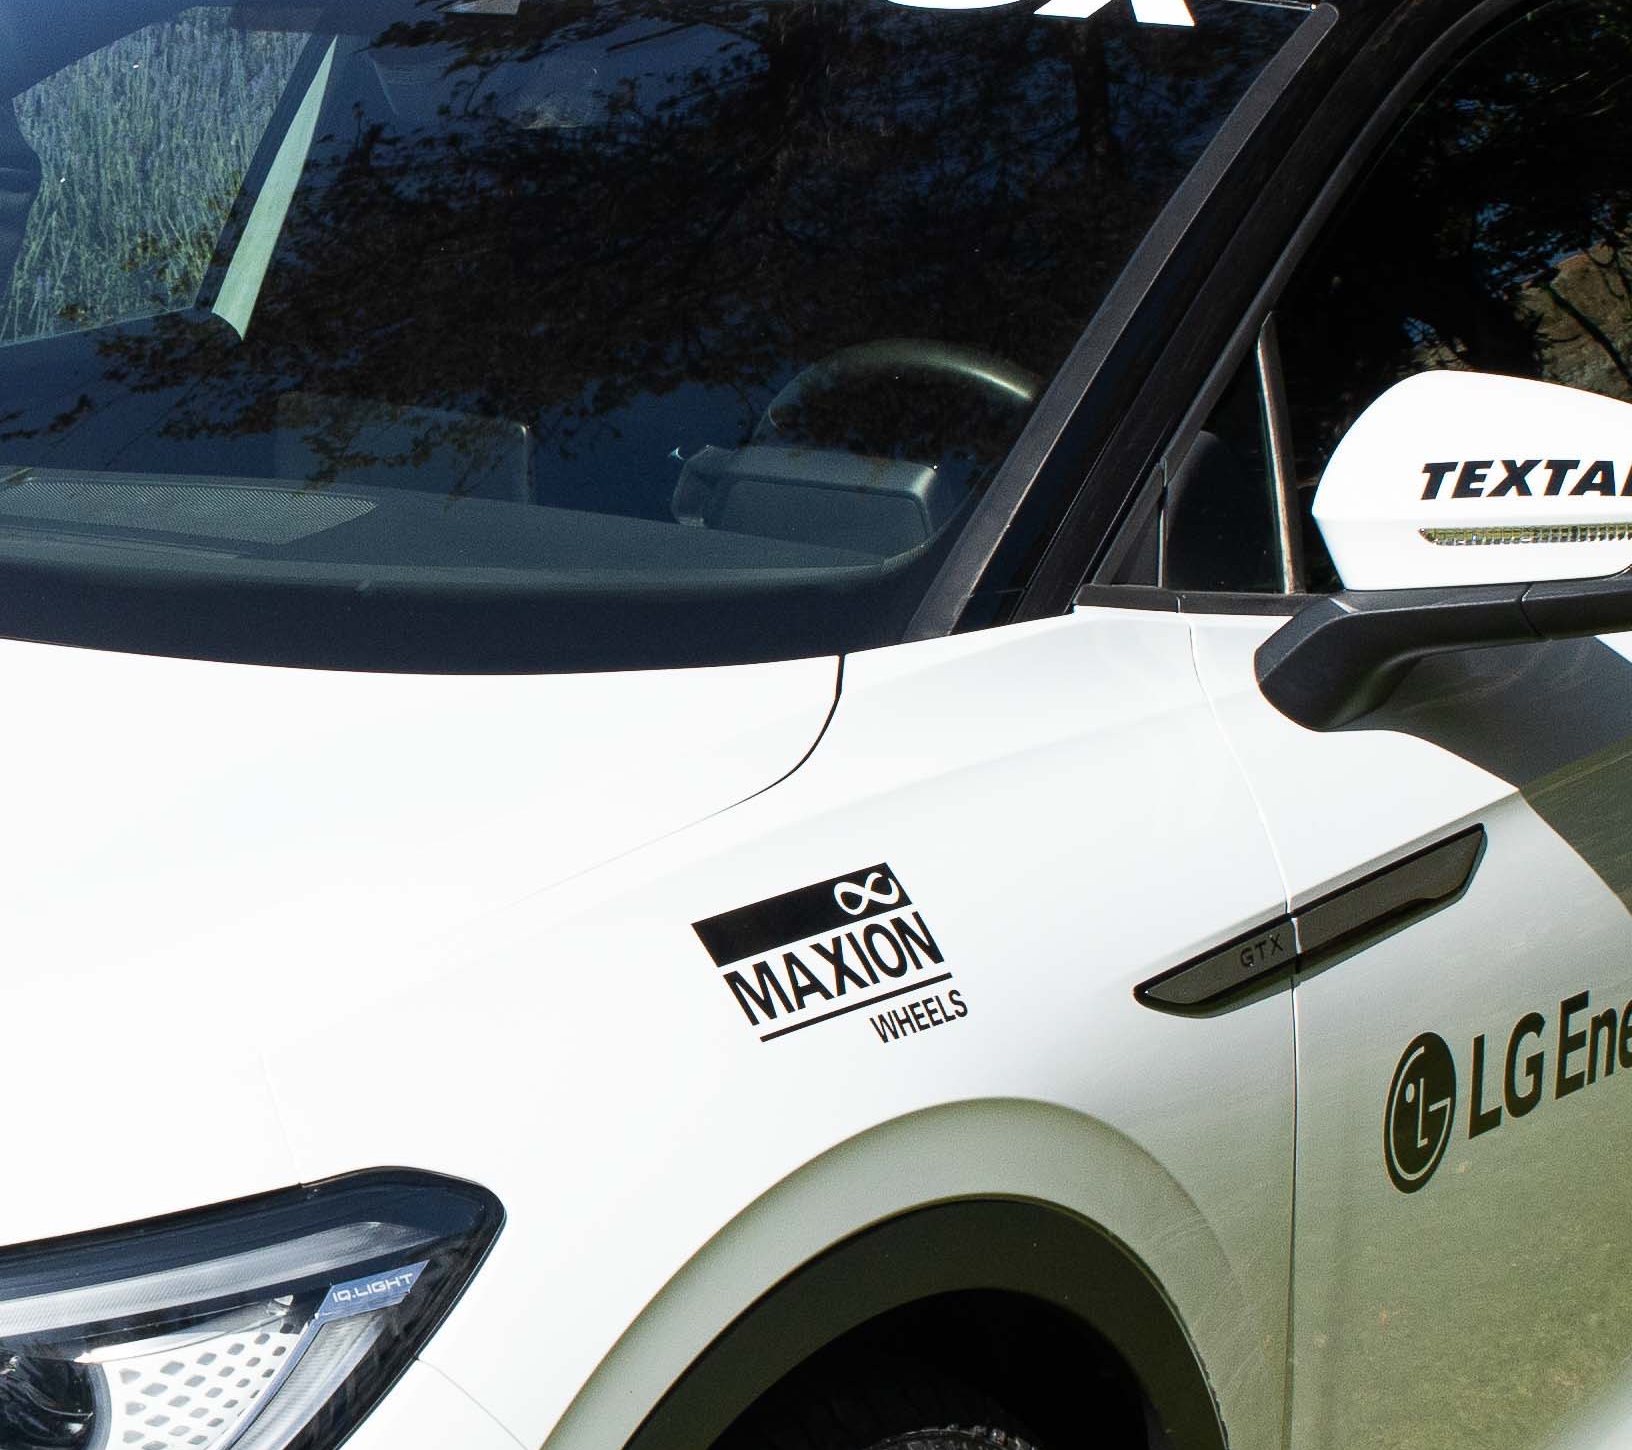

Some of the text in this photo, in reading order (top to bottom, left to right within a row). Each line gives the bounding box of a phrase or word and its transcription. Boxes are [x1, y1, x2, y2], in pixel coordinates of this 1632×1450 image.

[722, 912, 945, 1027] MAXION
[1239, 933, 1284, 968] GTX
[869, 989, 968, 1044] WHEELS
[1468, 1012, 1545, 1141] LG
[332, 1273, 413, 1303] IQ.LIGHT
